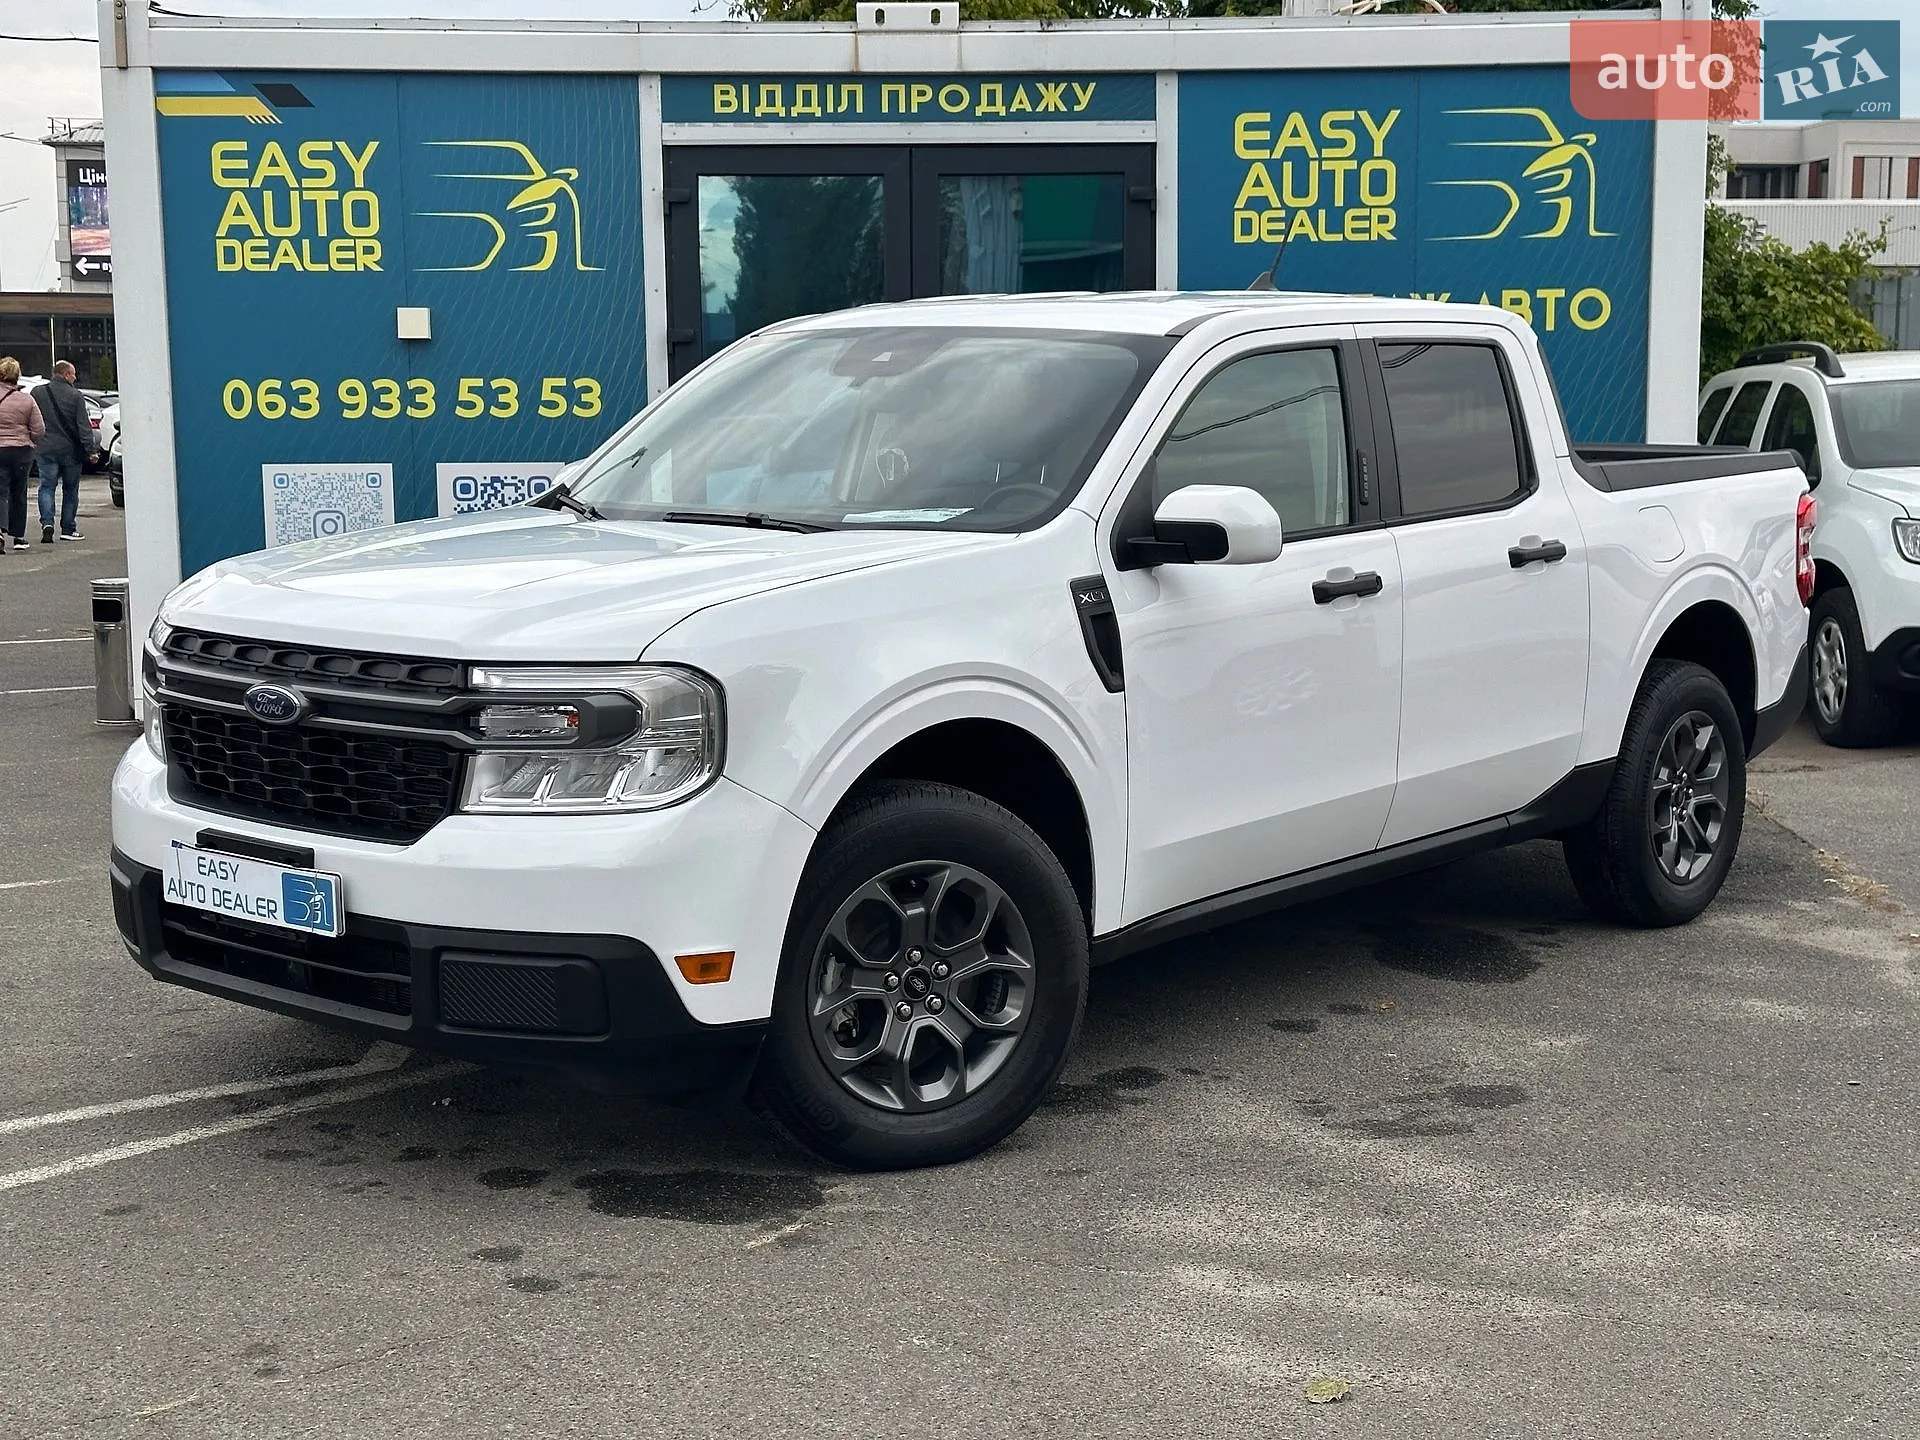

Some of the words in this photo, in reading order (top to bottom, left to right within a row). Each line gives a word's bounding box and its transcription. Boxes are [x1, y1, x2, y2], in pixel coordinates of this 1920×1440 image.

[713, 83, 864, 118] ВІДДІЛ
[881, 82, 1097, 117] ПРОДАЖУ
[1234, 109, 1401, 160] EASY
[79, 167, 107, 186] Цін
[211, 140, 380, 188] EASY
[1233, 159, 1397, 209] AUTO
[215, 190, 380, 237] AUTO
[1233, 207, 1398, 243] DEALER
[215, 238, 385, 272] DEALER
[1479, 287, 1612, 331] ВТО
[222, 378, 321, 420] 063
[337, 378, 437, 420] 933
[454, 377, 520, 419] 53
[537, 377, 603, 419] 53
[254, 692, 286, 715] Ford
[197, 856, 240, 882] EASY
[167, 877, 206, 904] AUTO
[212, 887, 278, 920] DEALER
